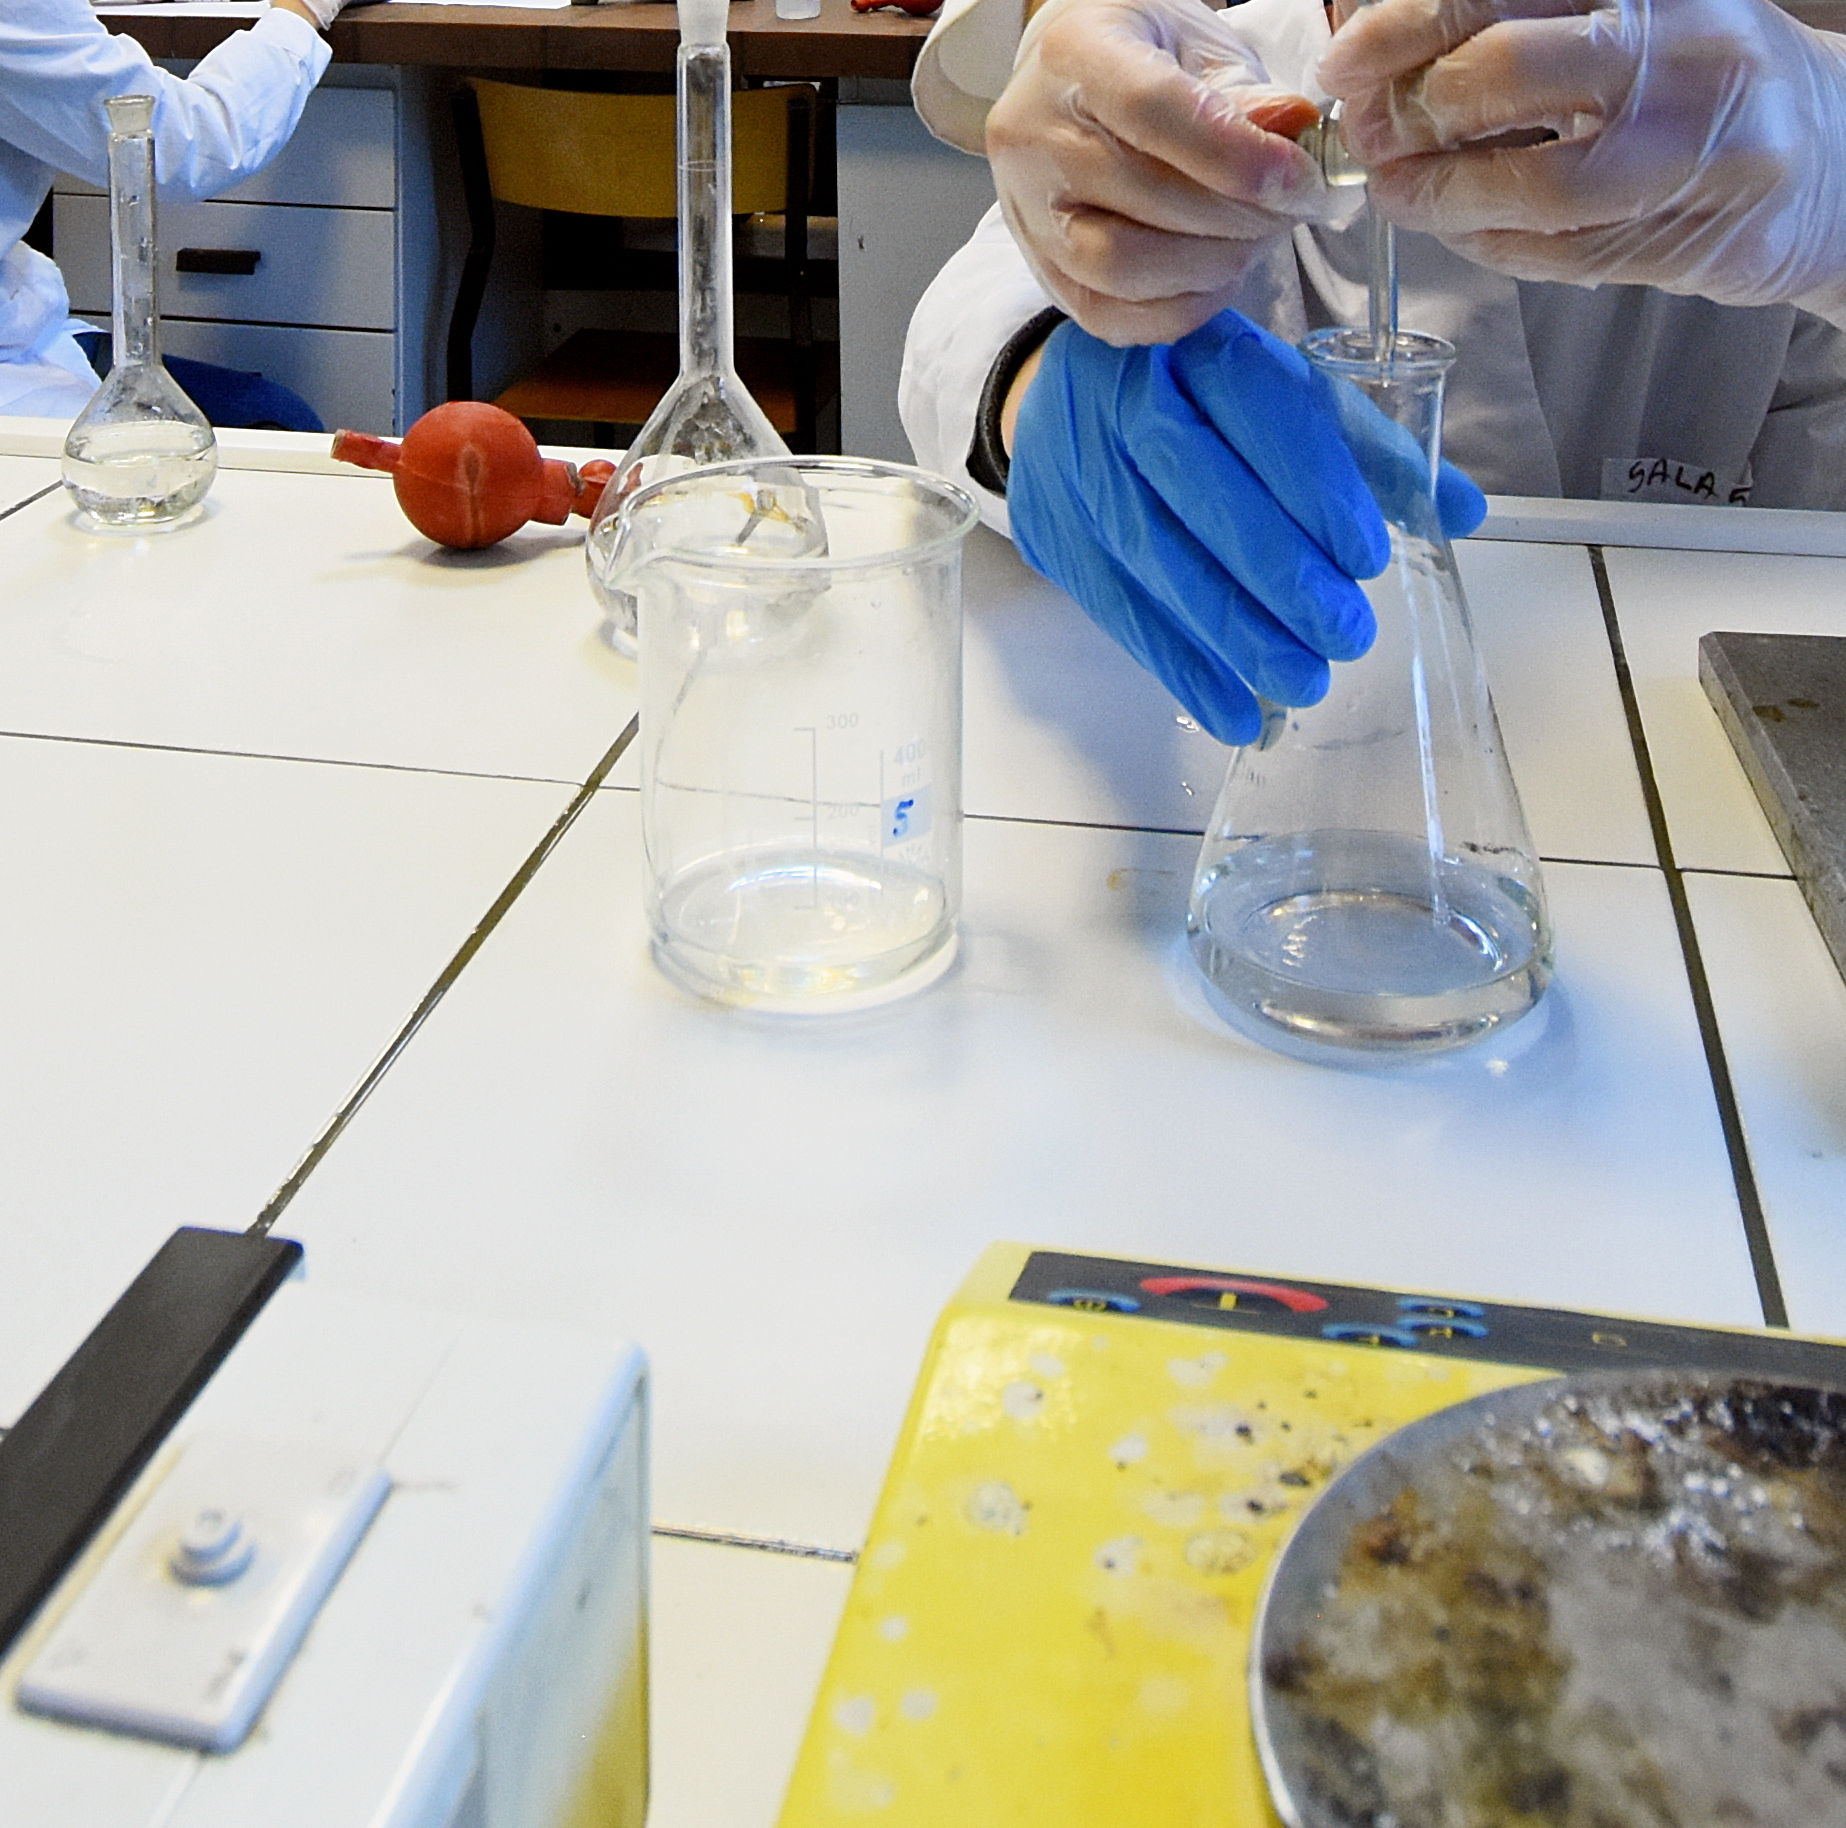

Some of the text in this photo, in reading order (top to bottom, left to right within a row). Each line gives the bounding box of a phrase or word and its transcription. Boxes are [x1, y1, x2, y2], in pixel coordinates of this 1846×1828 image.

[1629, 459, 1718, 499] SALA
[826, 712, 859, 730] 300
[893, 738, 927, 764] 400
[827, 803, 859, 821] 200
[891, 797, 915, 840] 5
